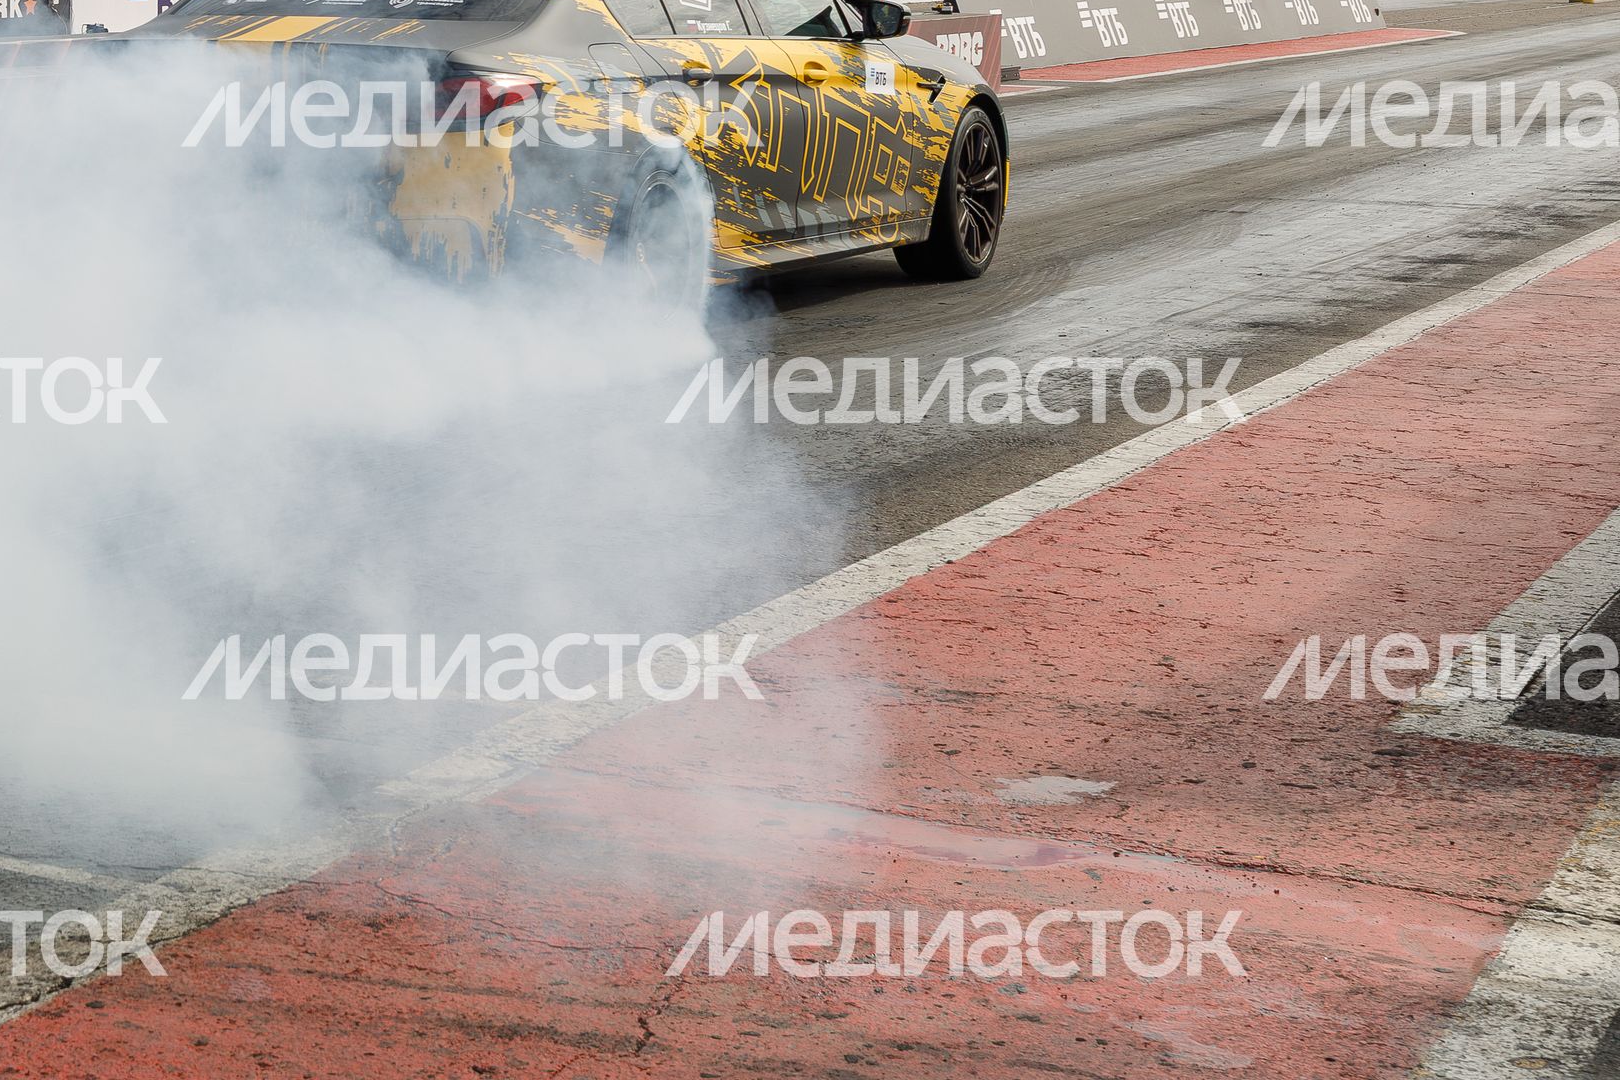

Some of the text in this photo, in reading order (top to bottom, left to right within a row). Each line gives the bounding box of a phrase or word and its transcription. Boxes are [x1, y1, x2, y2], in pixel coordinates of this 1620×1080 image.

[1007, 16, 1046, 59] ВТБ
[1091, 8, 1129, 48] ВТБ
[1166, 2, 1200, 38] ВТБ
[874, 71, 886, 86] ВТБ
